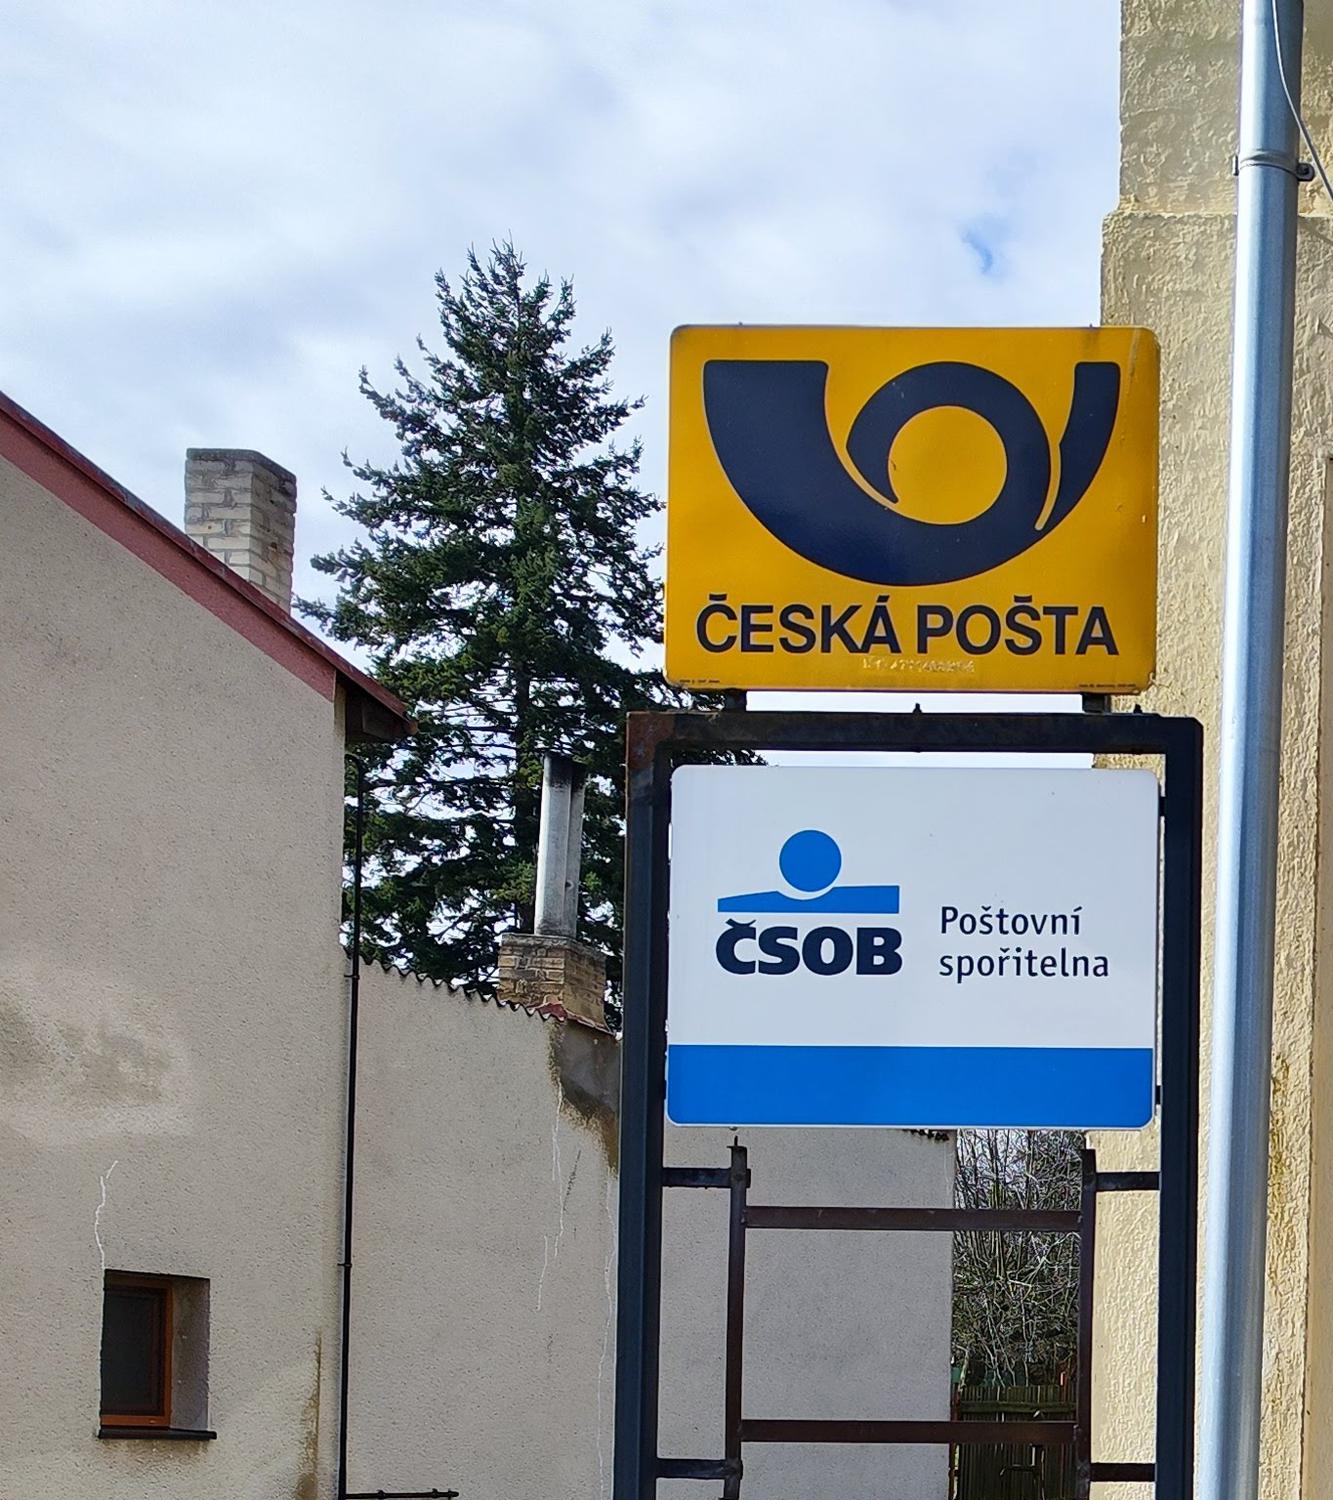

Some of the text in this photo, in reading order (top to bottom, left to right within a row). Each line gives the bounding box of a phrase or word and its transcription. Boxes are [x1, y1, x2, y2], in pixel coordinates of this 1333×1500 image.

[696, 593, 1120, 656] ČESKÁ POŠTA
[940, 906, 1084, 936] Poštovní
[715, 918, 903, 976] ČSOB
[939, 947, 1110, 984] spořitelna
